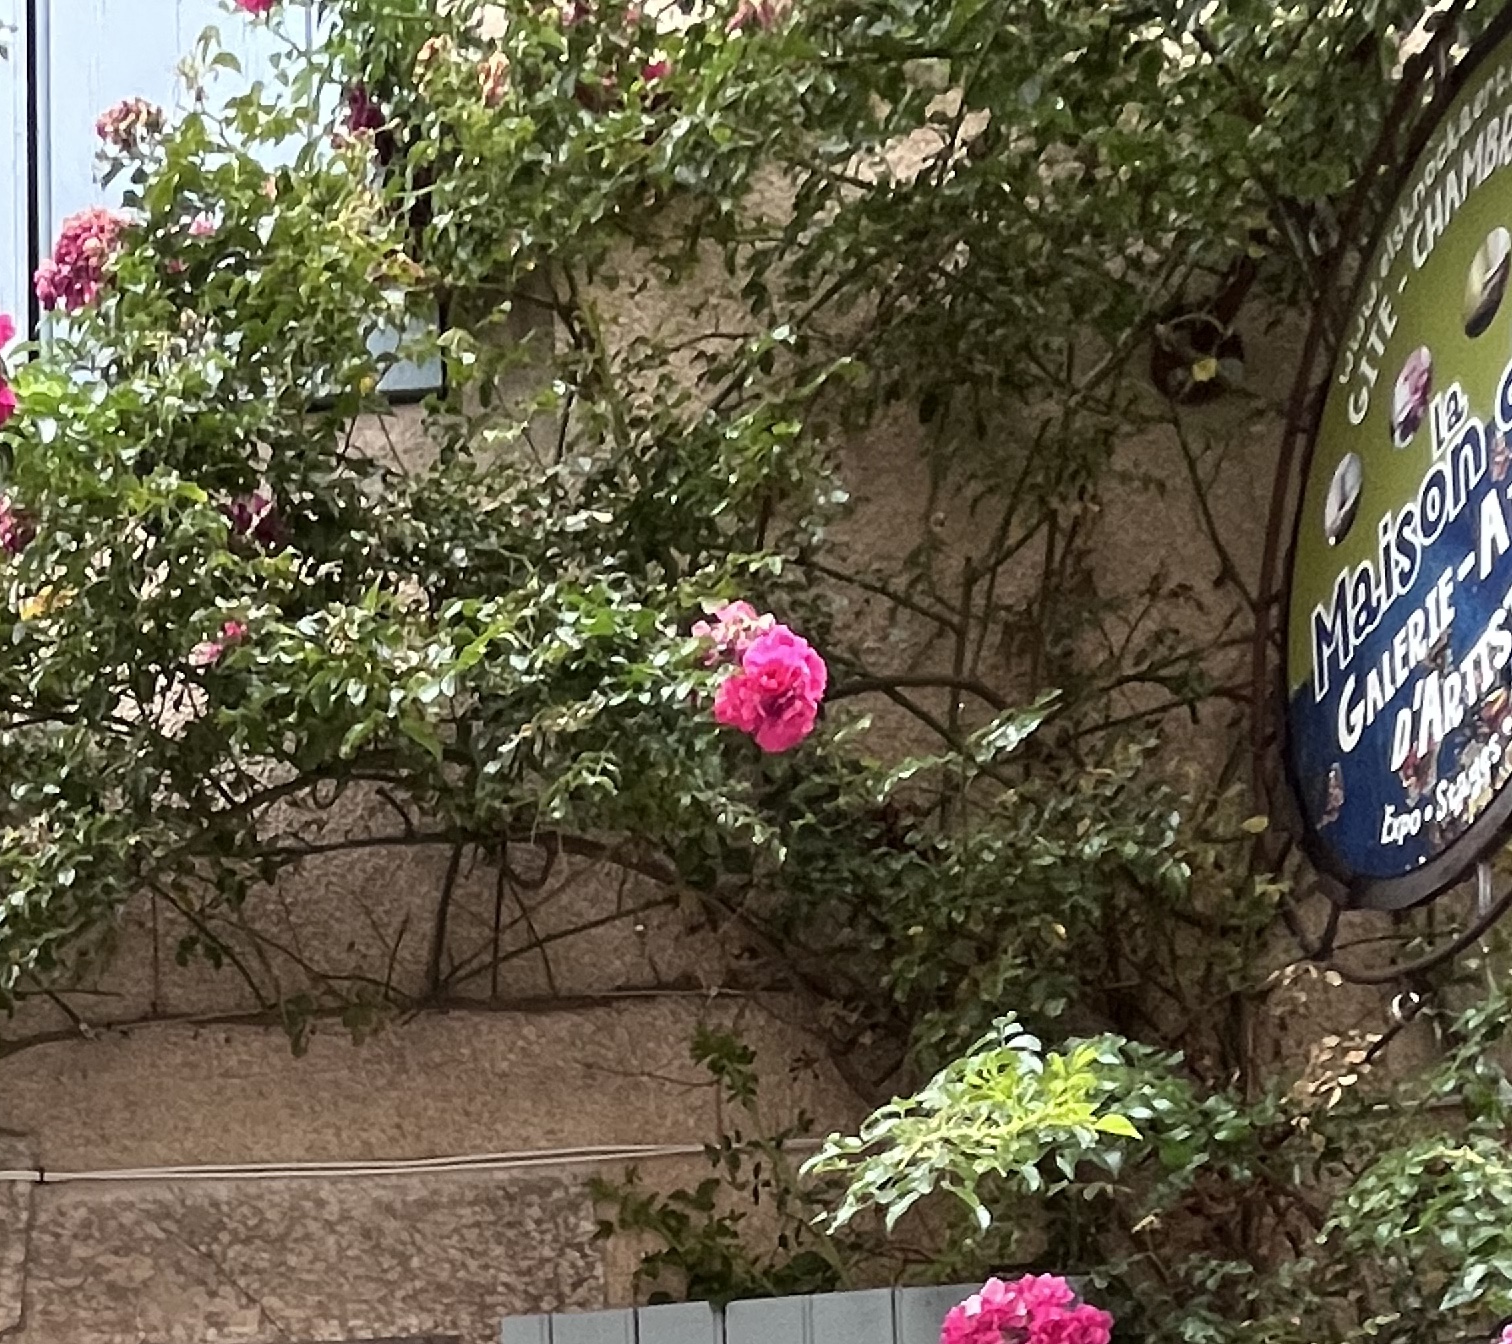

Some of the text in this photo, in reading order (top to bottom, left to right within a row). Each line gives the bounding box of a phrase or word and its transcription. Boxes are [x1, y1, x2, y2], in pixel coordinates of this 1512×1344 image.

[1429, 381, 1470, 463] la
[1311, 416, 1487, 701] Maison
[1381, 803, 1422, 845] Expo
